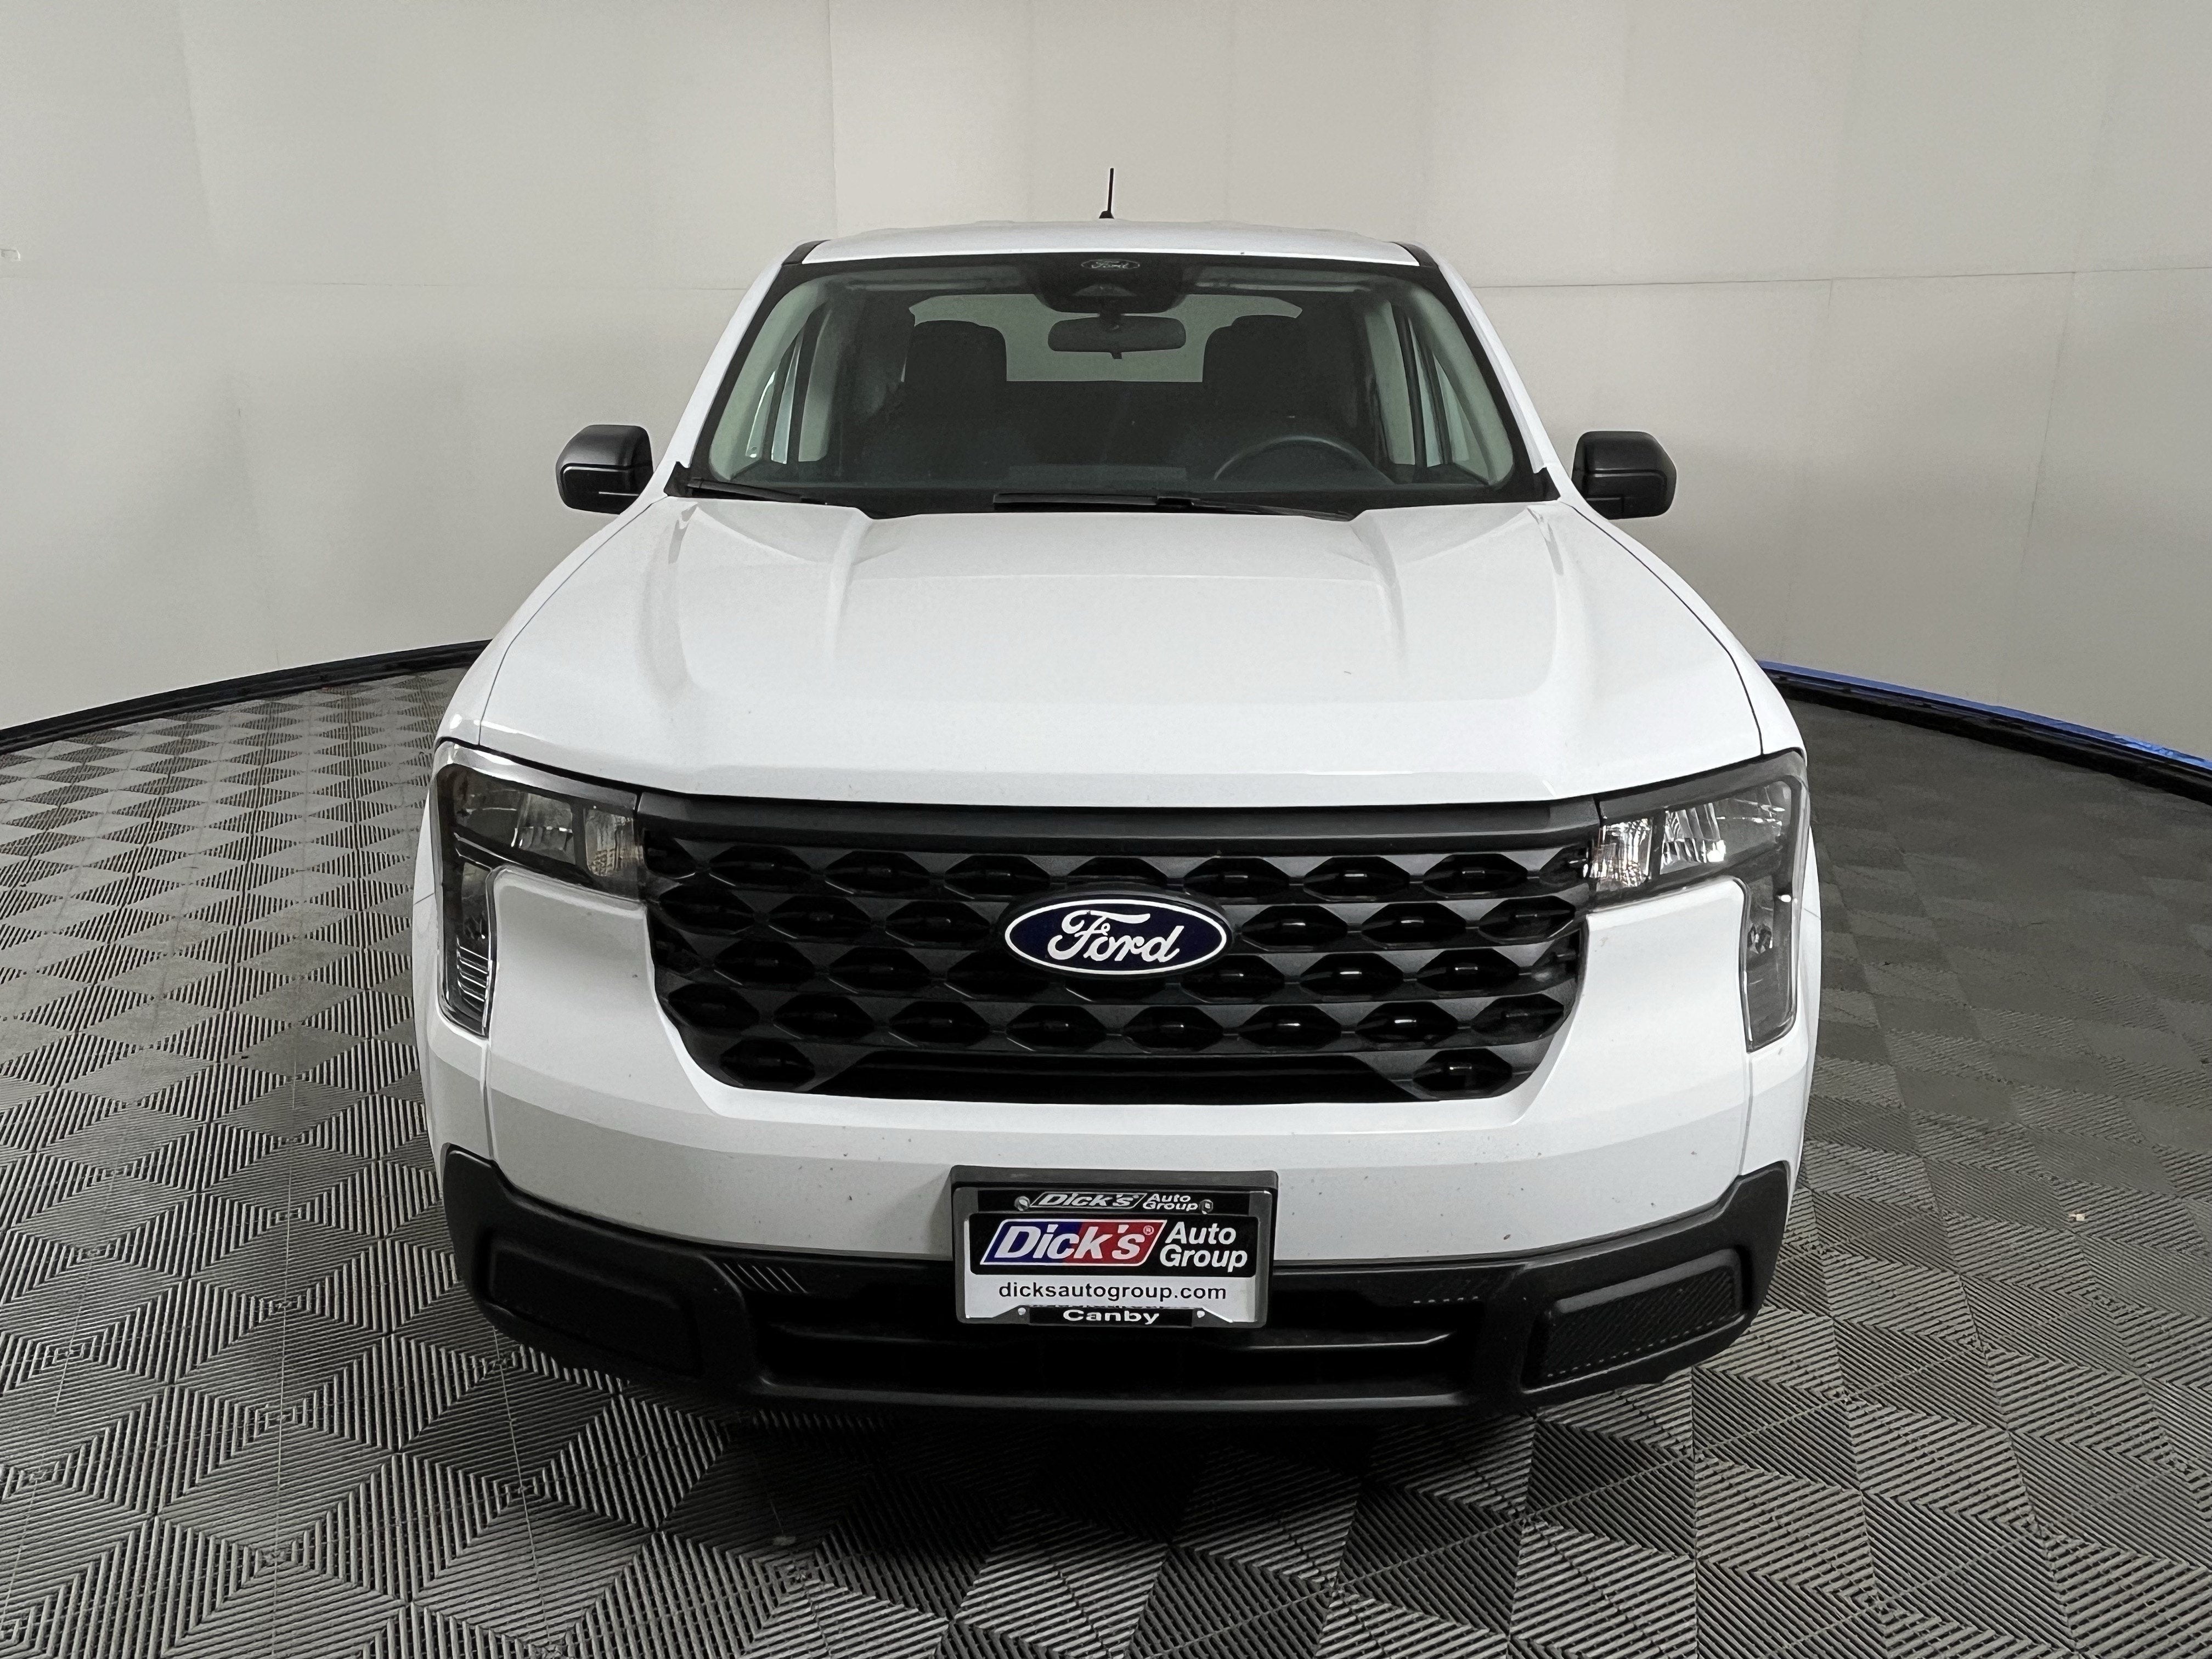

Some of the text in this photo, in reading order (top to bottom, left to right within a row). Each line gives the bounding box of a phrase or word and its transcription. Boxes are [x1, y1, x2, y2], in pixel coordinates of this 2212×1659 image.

[1047, 909, 1184, 962] Ford
[1142, 1201, 1198, 1211] Group
[1147, 1193, 1191, 1203] Auto
[994, 1221, 1237, 1260] Dick's Auto
[1160, 1245, 1248, 1273] Group
[998, 1282, 1227, 1301] dicksautogroup.com
[1063, 1309, 1160, 1325] Canby
